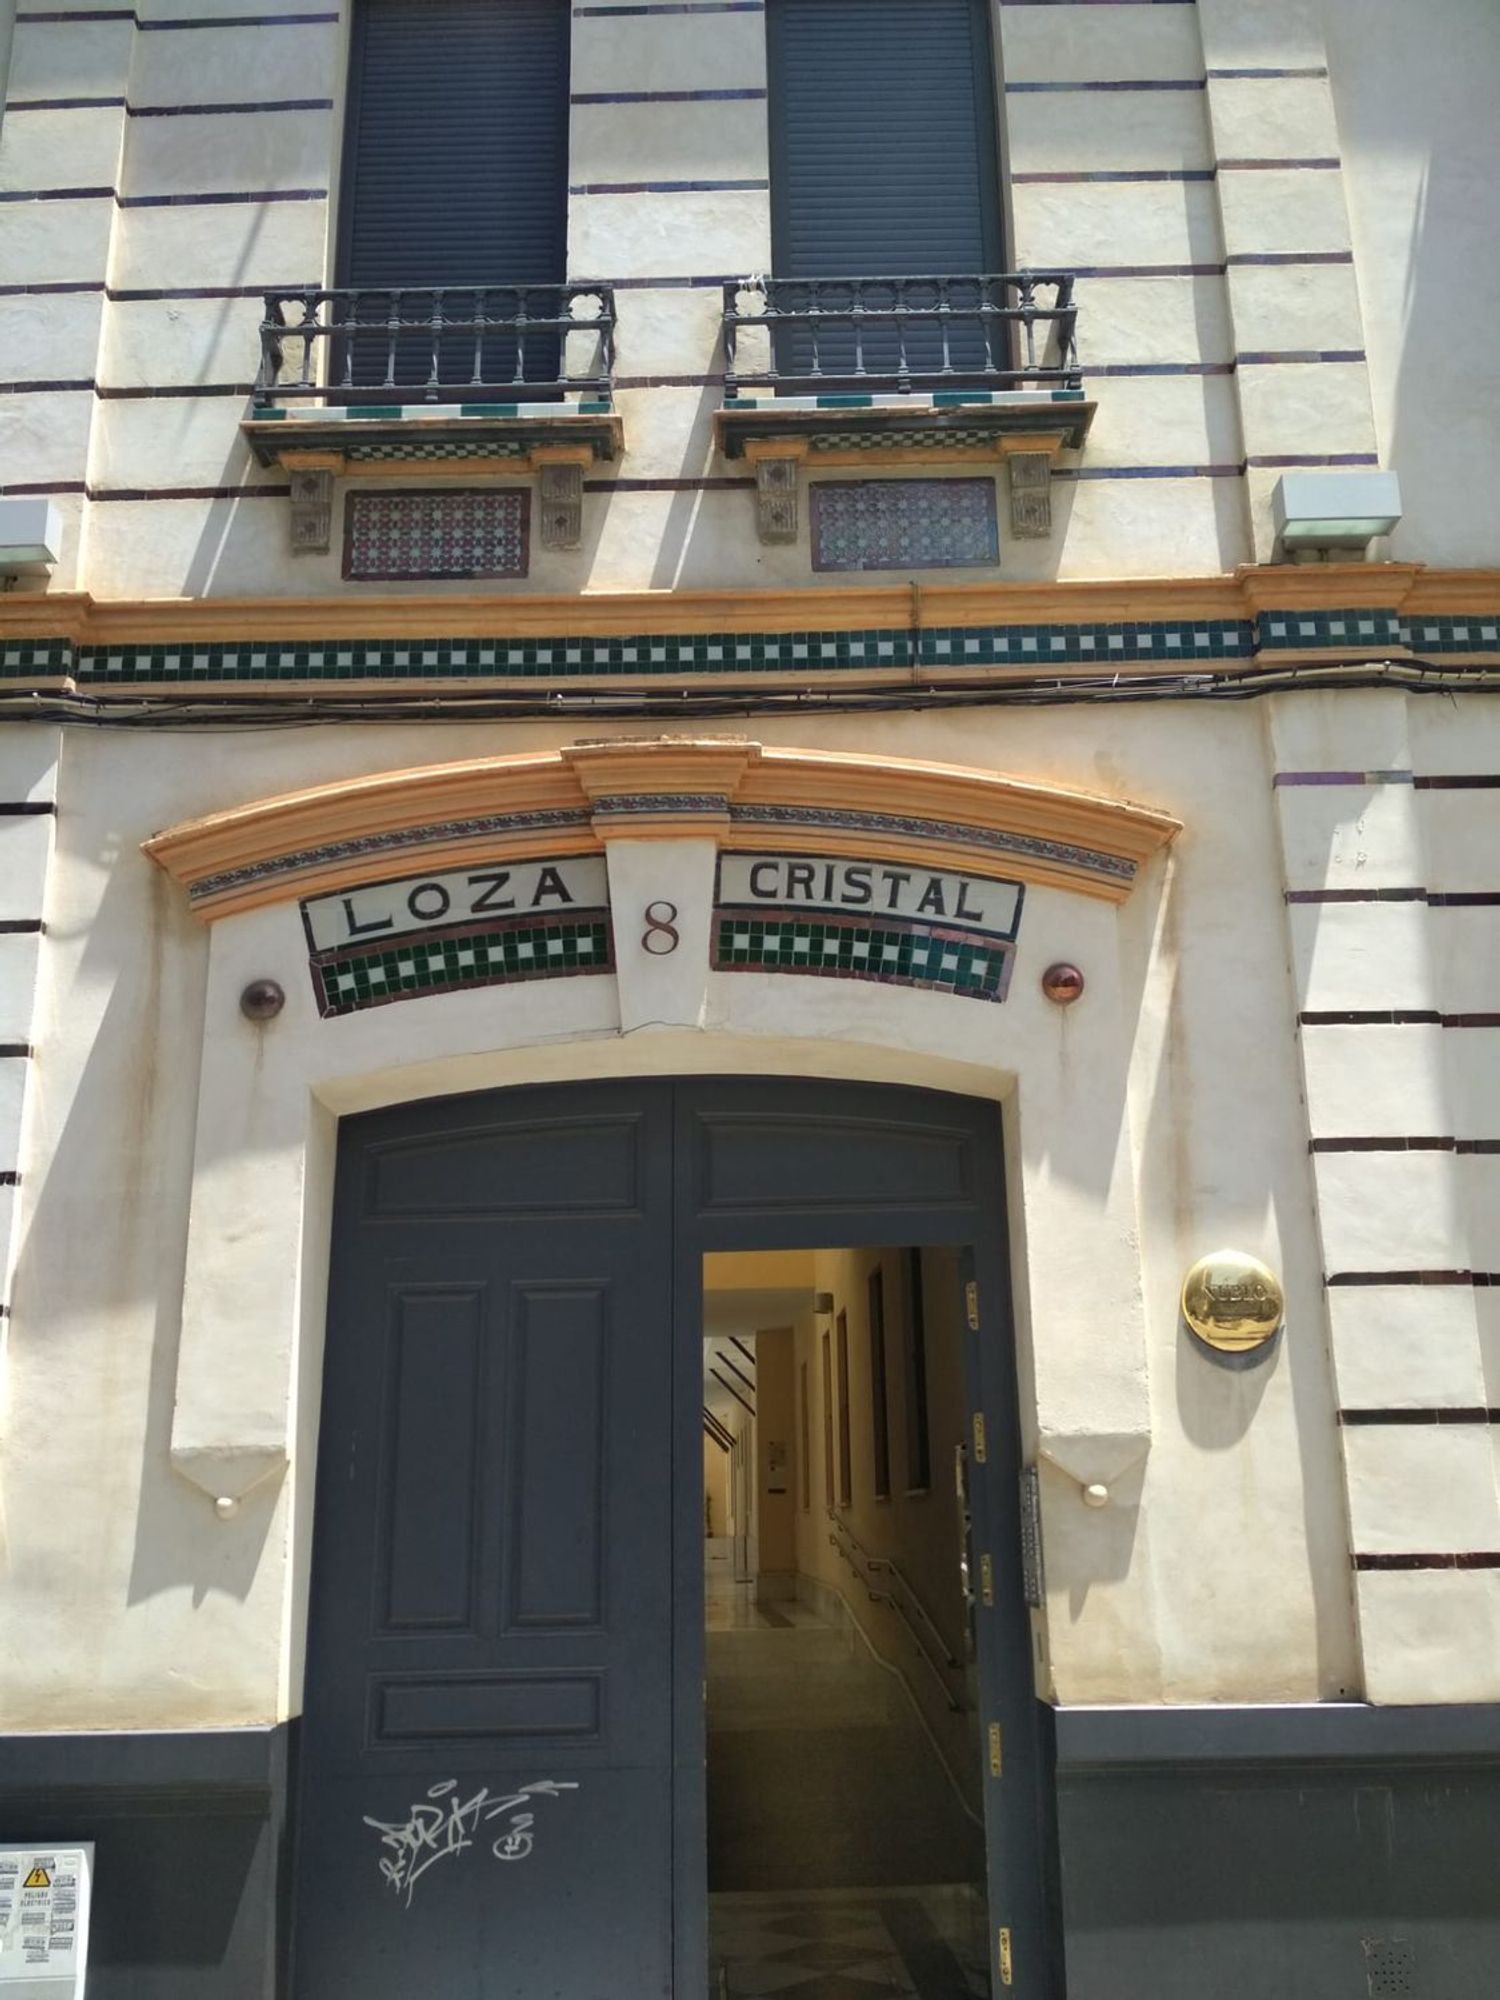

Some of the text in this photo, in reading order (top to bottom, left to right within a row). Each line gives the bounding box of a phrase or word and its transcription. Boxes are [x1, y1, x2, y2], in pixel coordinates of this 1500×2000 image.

[342, 867, 574, 936] LOZA
[749, 861, 985, 922] CRISTAL
[641, 901, 680, 956] 8
